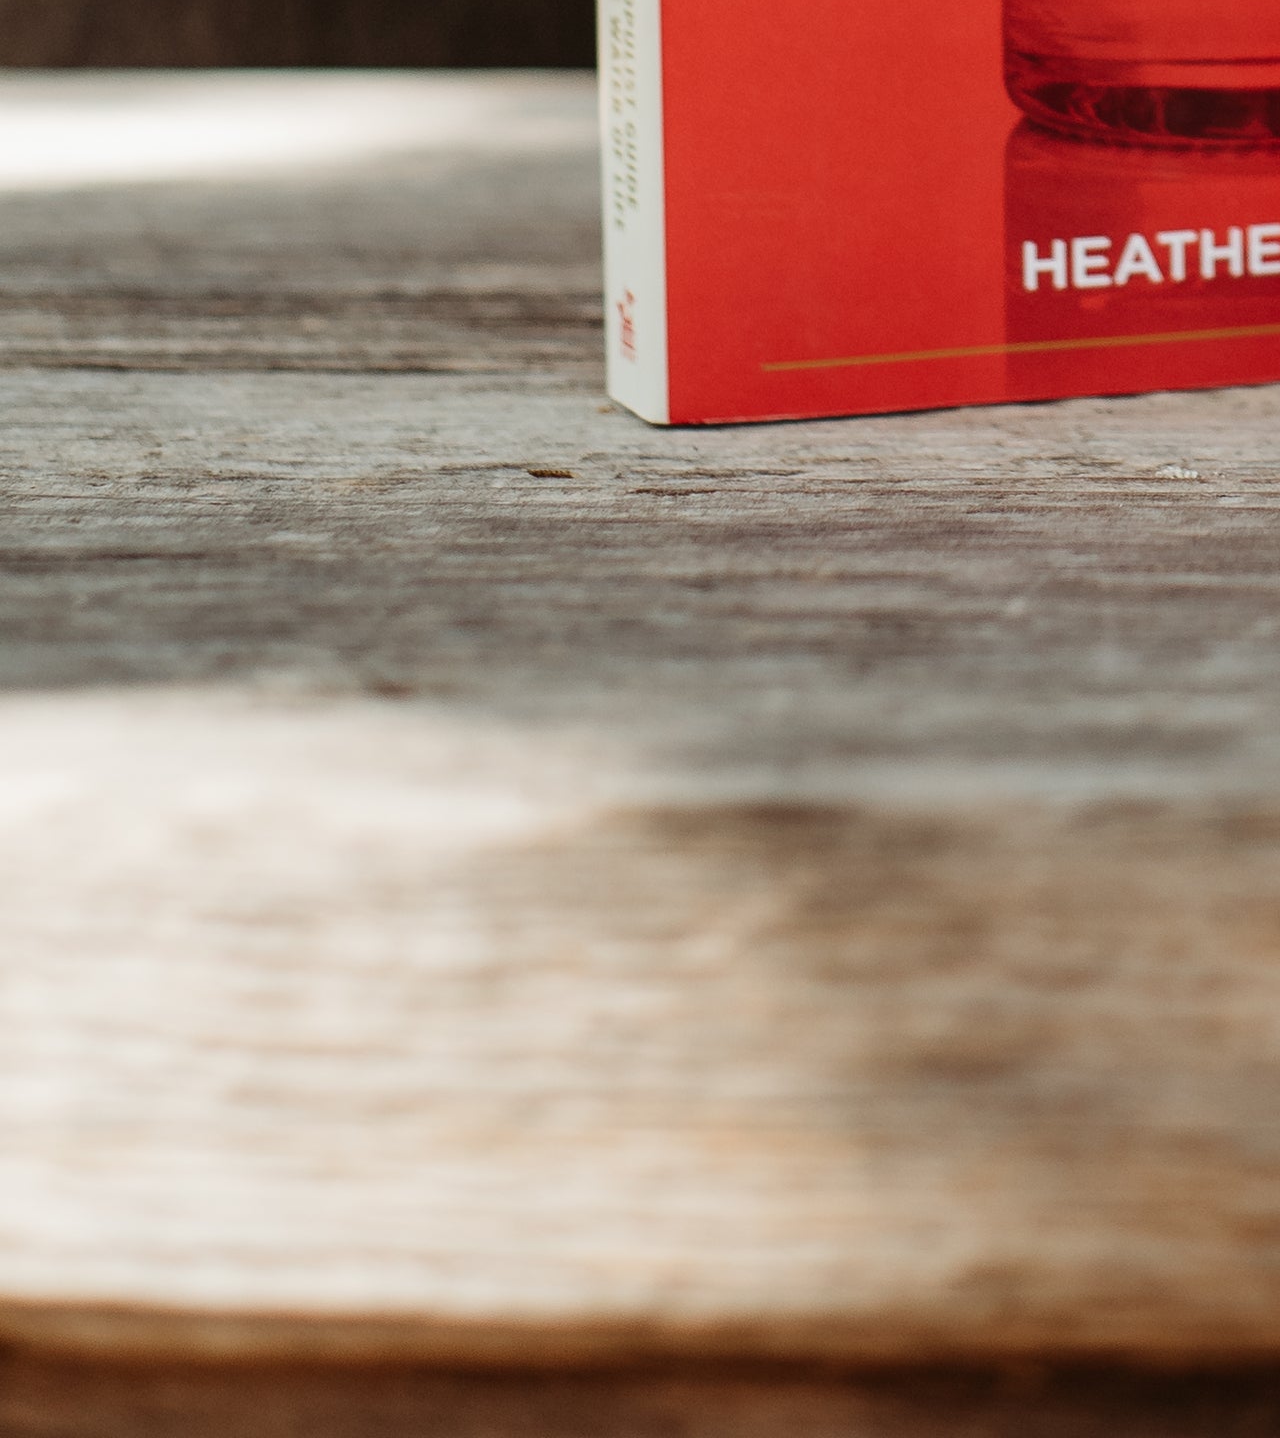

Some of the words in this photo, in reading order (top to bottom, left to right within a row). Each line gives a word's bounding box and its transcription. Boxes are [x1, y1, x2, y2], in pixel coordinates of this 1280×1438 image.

[609, 15, 624, 115] WATER
[612, 126, 624, 159] OF
[625, 120, 640, 211] GUIDE
[613, 172, 627, 233] LIFE
